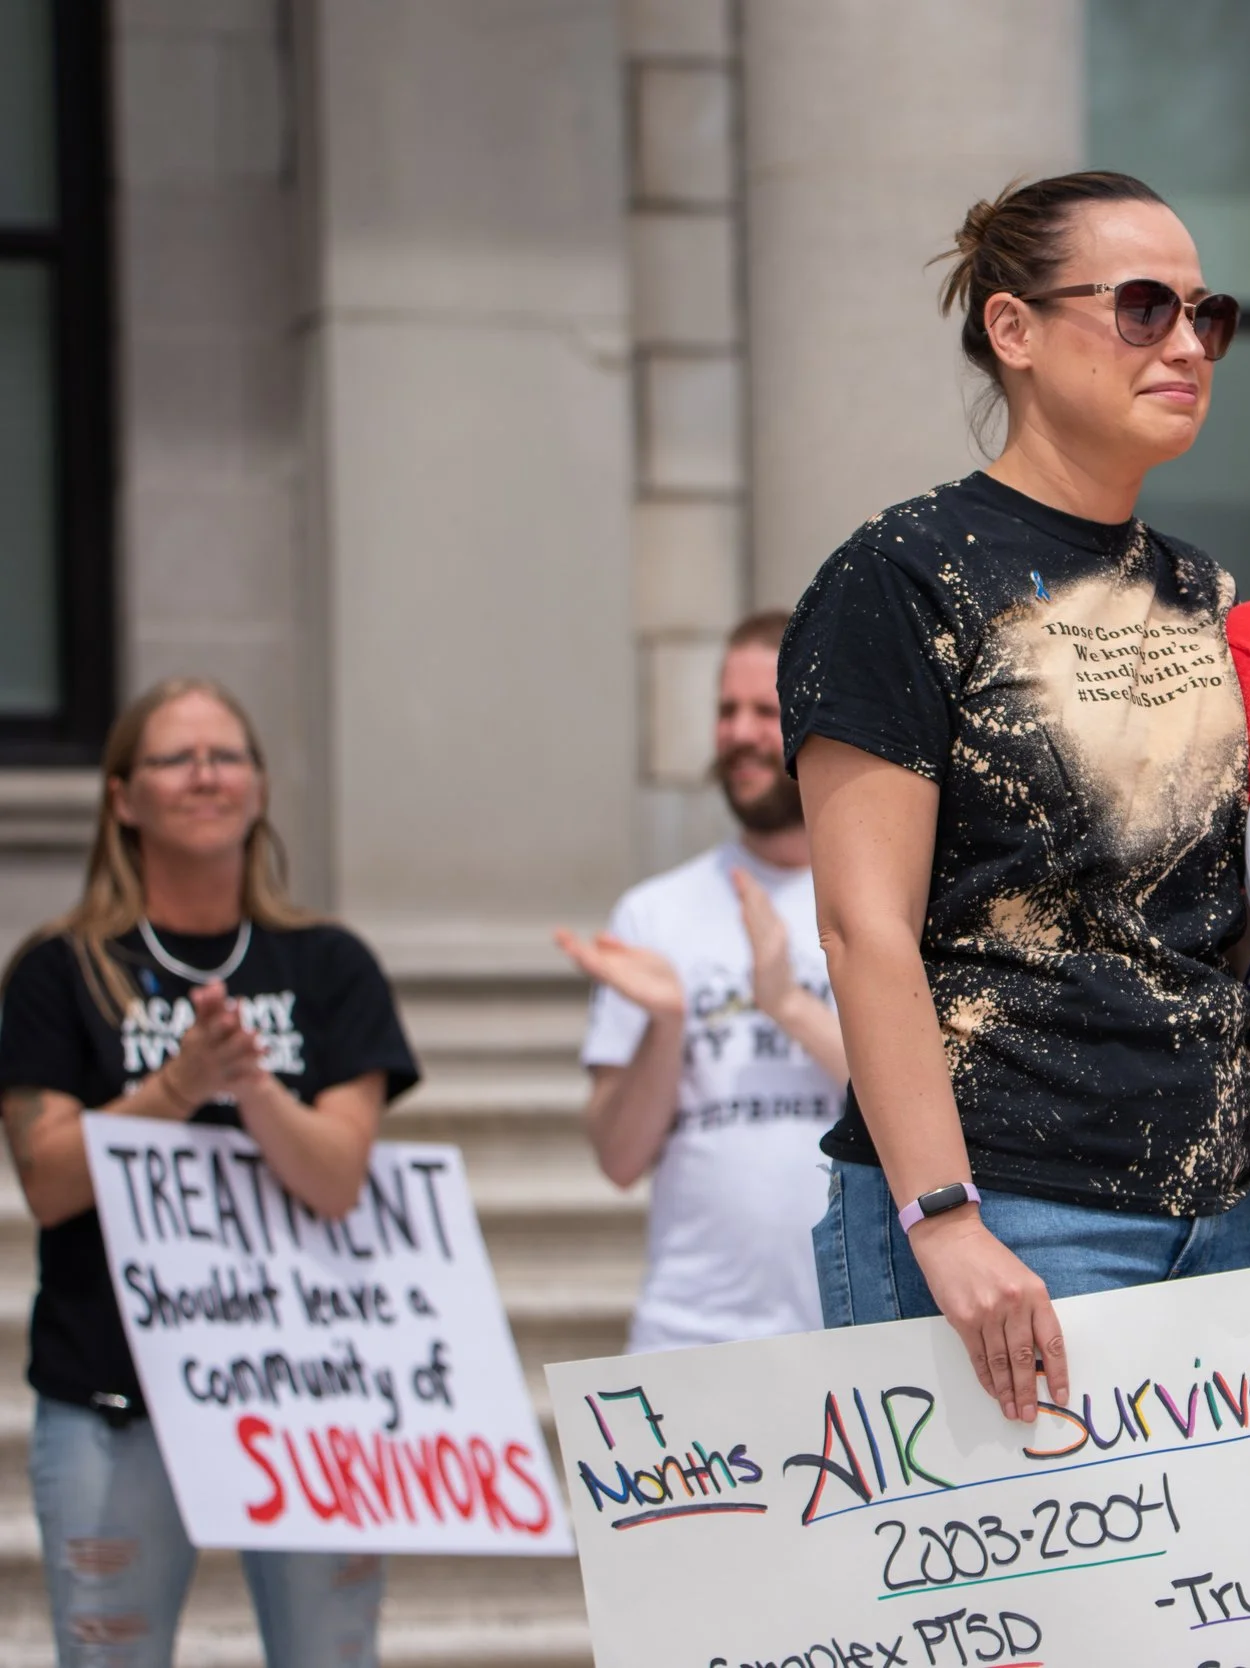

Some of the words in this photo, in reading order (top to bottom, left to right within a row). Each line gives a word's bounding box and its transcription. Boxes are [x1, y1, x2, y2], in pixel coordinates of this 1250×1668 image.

[1041, 621, 1094, 640] Those
[1095, 623, 1145, 641] Gone
[1073, 643, 1101, 662] We
[1100, 643, 1142, 661] kno
[1139, 641, 1201, 665] you're
[1140, 662, 1190, 685] with
[1191, 654, 1216, 668] us
[292, 1266, 399, 1328] leave
[405, 1285, 438, 1319] a
[411, 1340, 454, 1409] of
[584, 1385, 667, 1451] 17
[235, 1414, 551, 1537] SURVIVORS
[577, 1440, 764, 1512] Months
[782, 1386, 960, 1527] AIR
[874, 1471, 1181, 1591] 2003-2004
[911, 1607, 1044, 1667] PTSD
